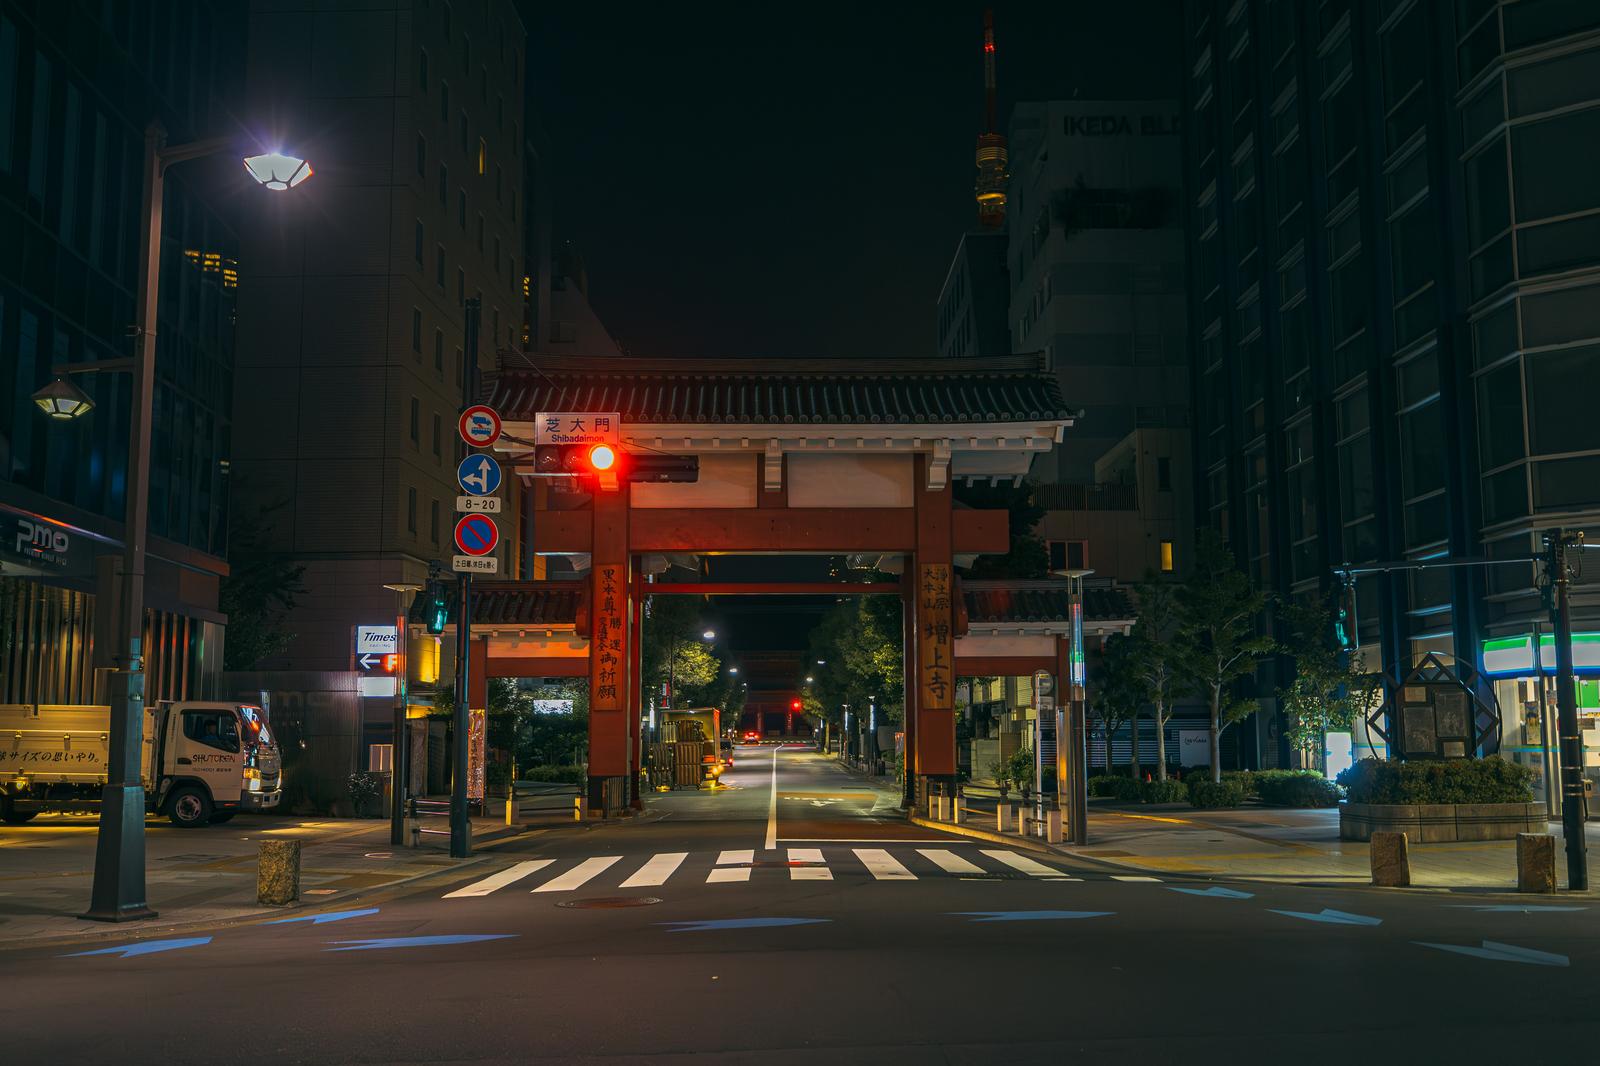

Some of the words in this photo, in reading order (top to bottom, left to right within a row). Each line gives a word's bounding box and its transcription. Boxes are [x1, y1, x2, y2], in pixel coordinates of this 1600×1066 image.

[1063, 115, 1132, 136] IKEDA
[545, 418, 610, 433] 芝大門
[551, 434, 605, 443] Shibadaimon
[364, 632, 397, 642] Times
